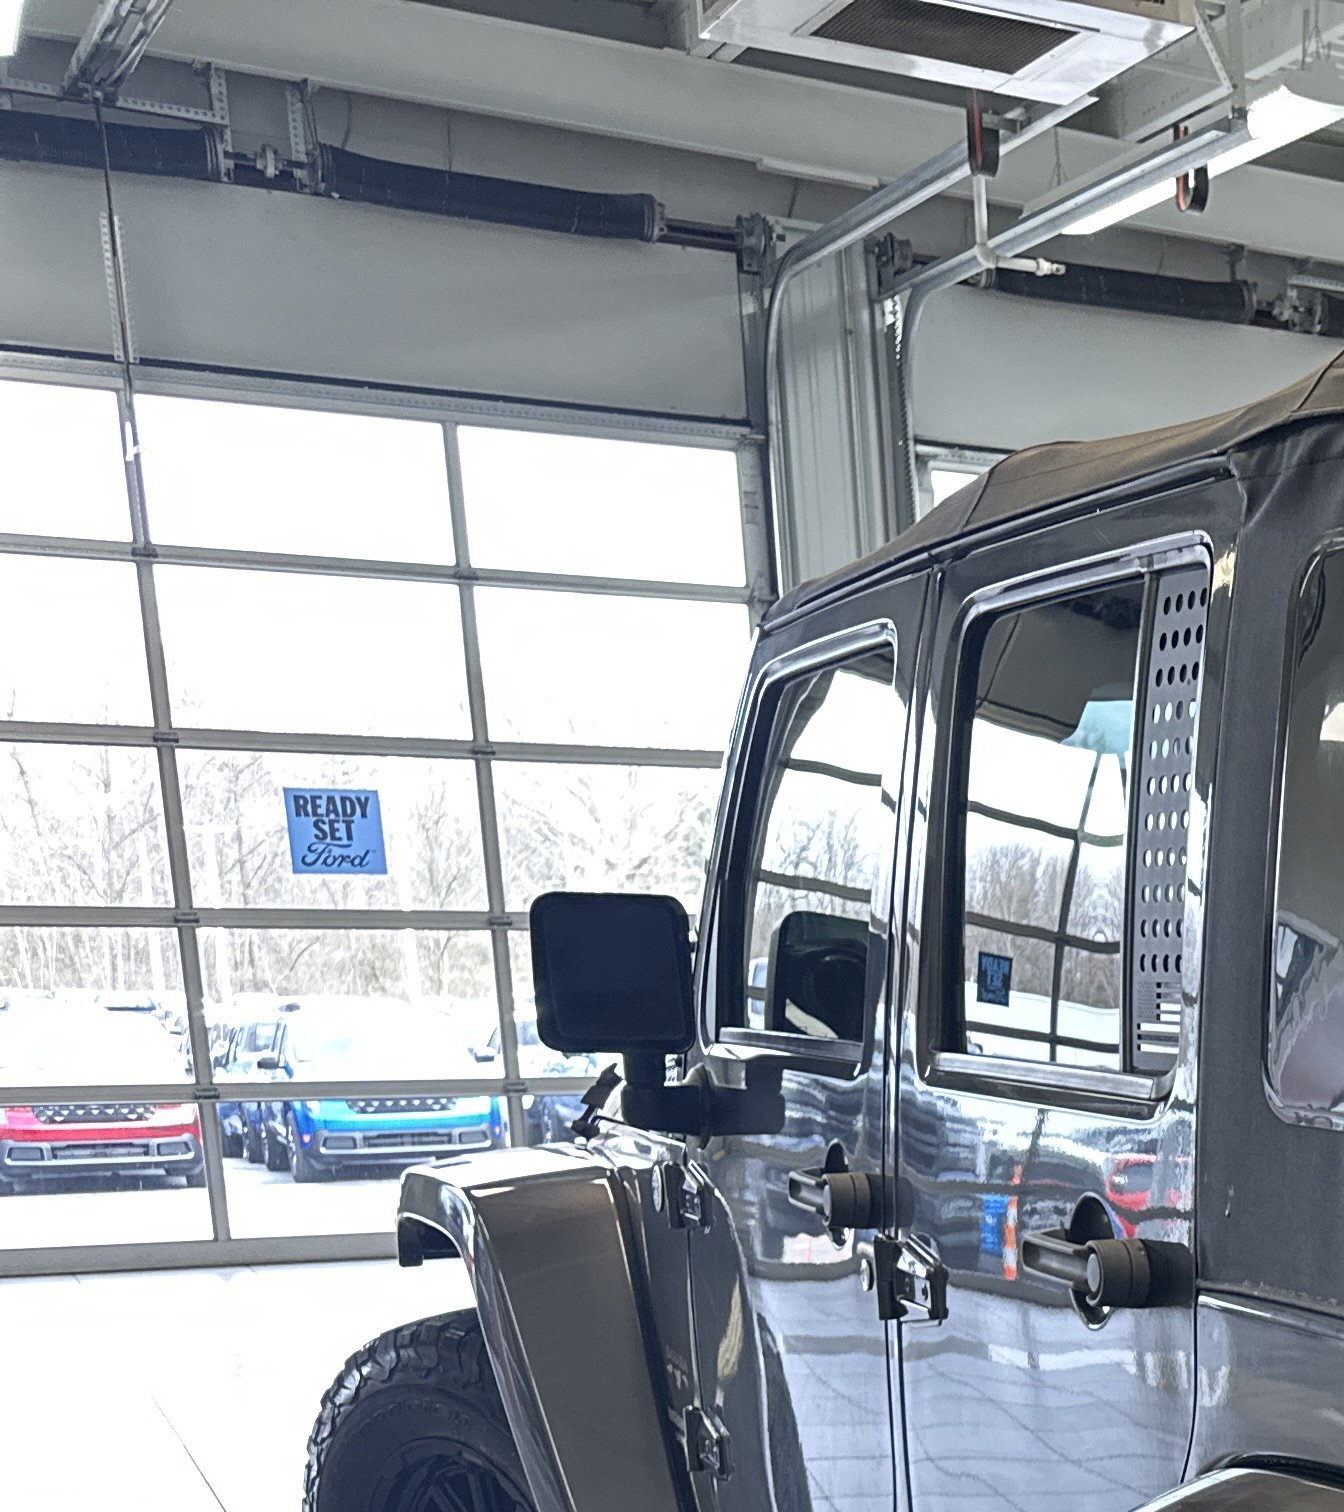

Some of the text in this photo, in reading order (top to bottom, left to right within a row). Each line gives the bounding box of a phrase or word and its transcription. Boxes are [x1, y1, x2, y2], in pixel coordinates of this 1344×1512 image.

[293, 794, 370, 819] READY
[313, 818, 355, 842] SET
[301, 841, 370, 868] Ford
